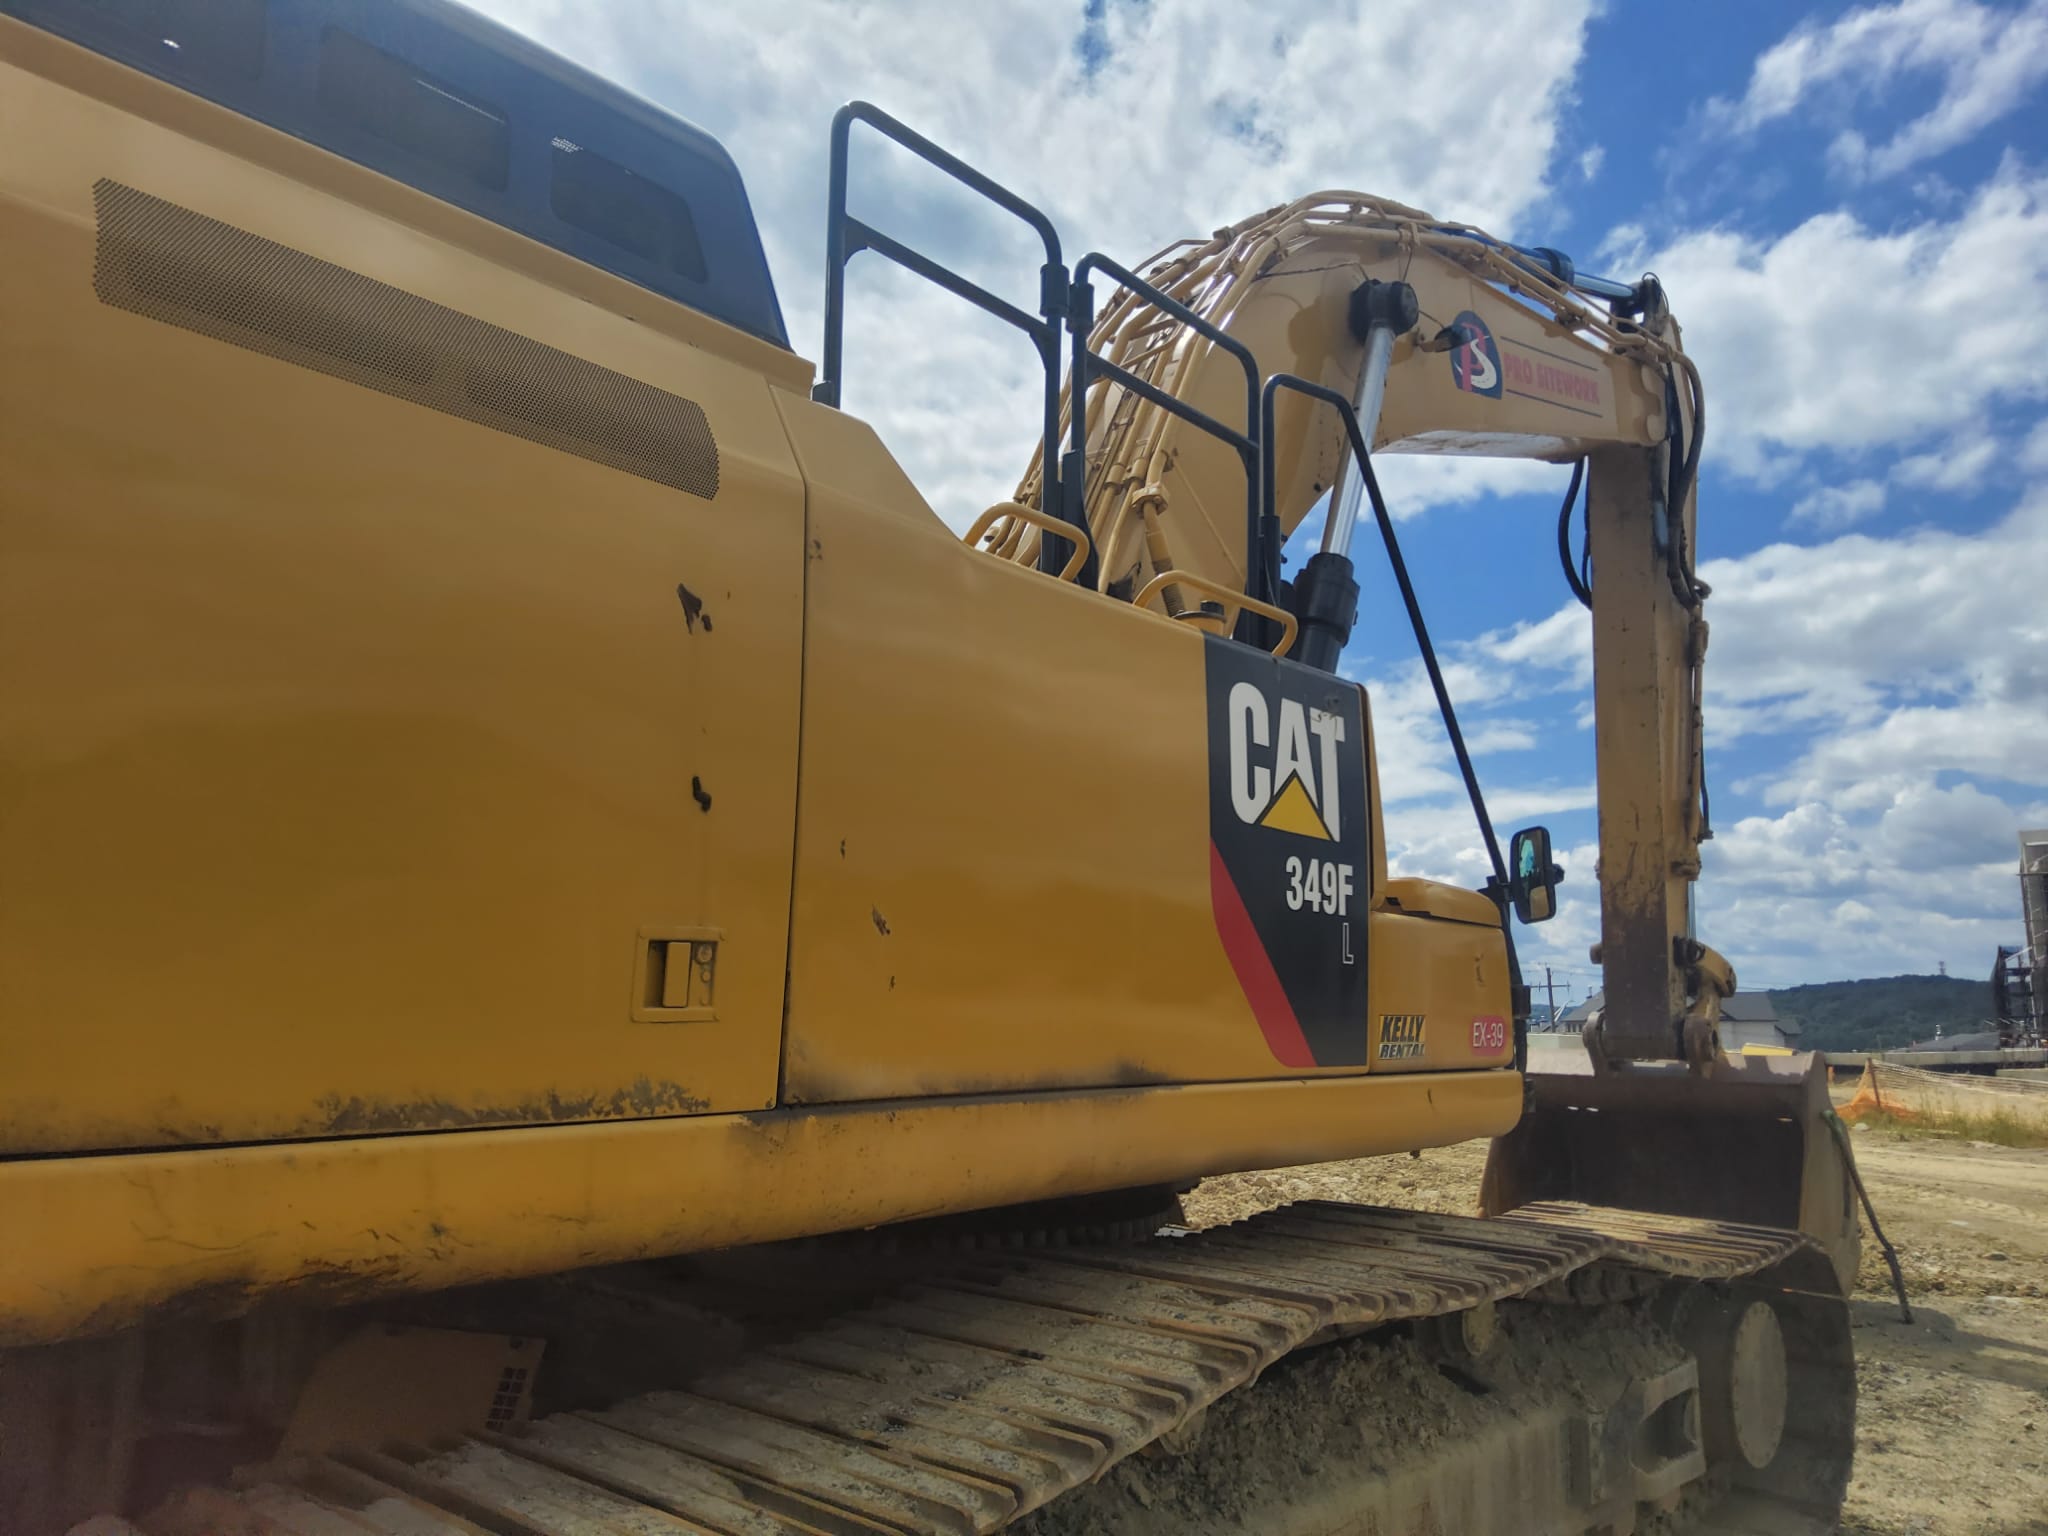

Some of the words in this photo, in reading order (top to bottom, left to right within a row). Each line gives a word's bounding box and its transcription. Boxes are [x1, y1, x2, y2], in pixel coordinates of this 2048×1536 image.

[1503, 352, 1533, 385] PRO
[1229, 682, 1345, 842] CAT
[1286, 856, 1353, 916] 349F
[1342, 922, 1354, 965] L
[1380, 1016, 1425, 1043] KELLY
[1472, 1022, 1504, 1048] EX-39
[1379, 1043, 1425, 1059] RENTAL
